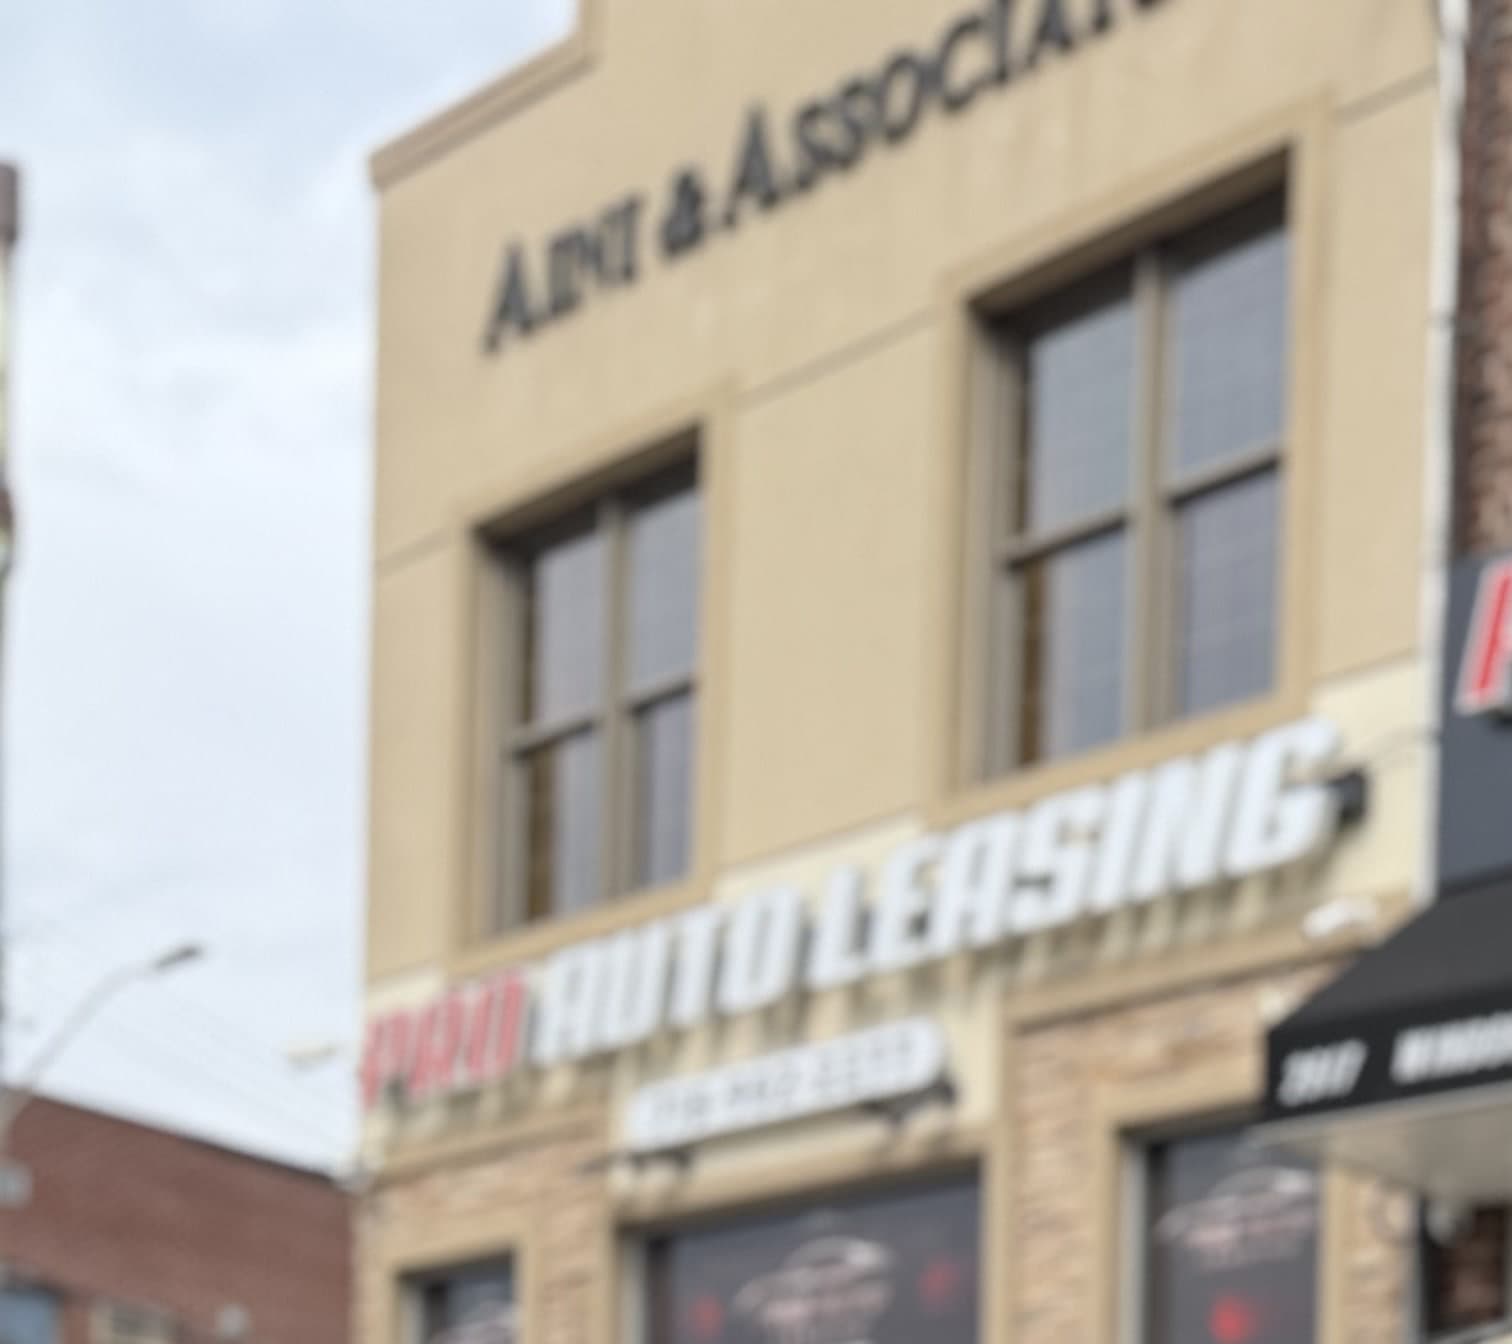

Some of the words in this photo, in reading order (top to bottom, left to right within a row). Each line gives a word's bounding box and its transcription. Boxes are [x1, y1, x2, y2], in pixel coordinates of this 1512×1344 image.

[660, 162, 708, 264] &
[359, 966, 528, 1108] PRO
[529, 884, 804, 1066] AUTO
[806, 715, 1342, 990] LEASING
